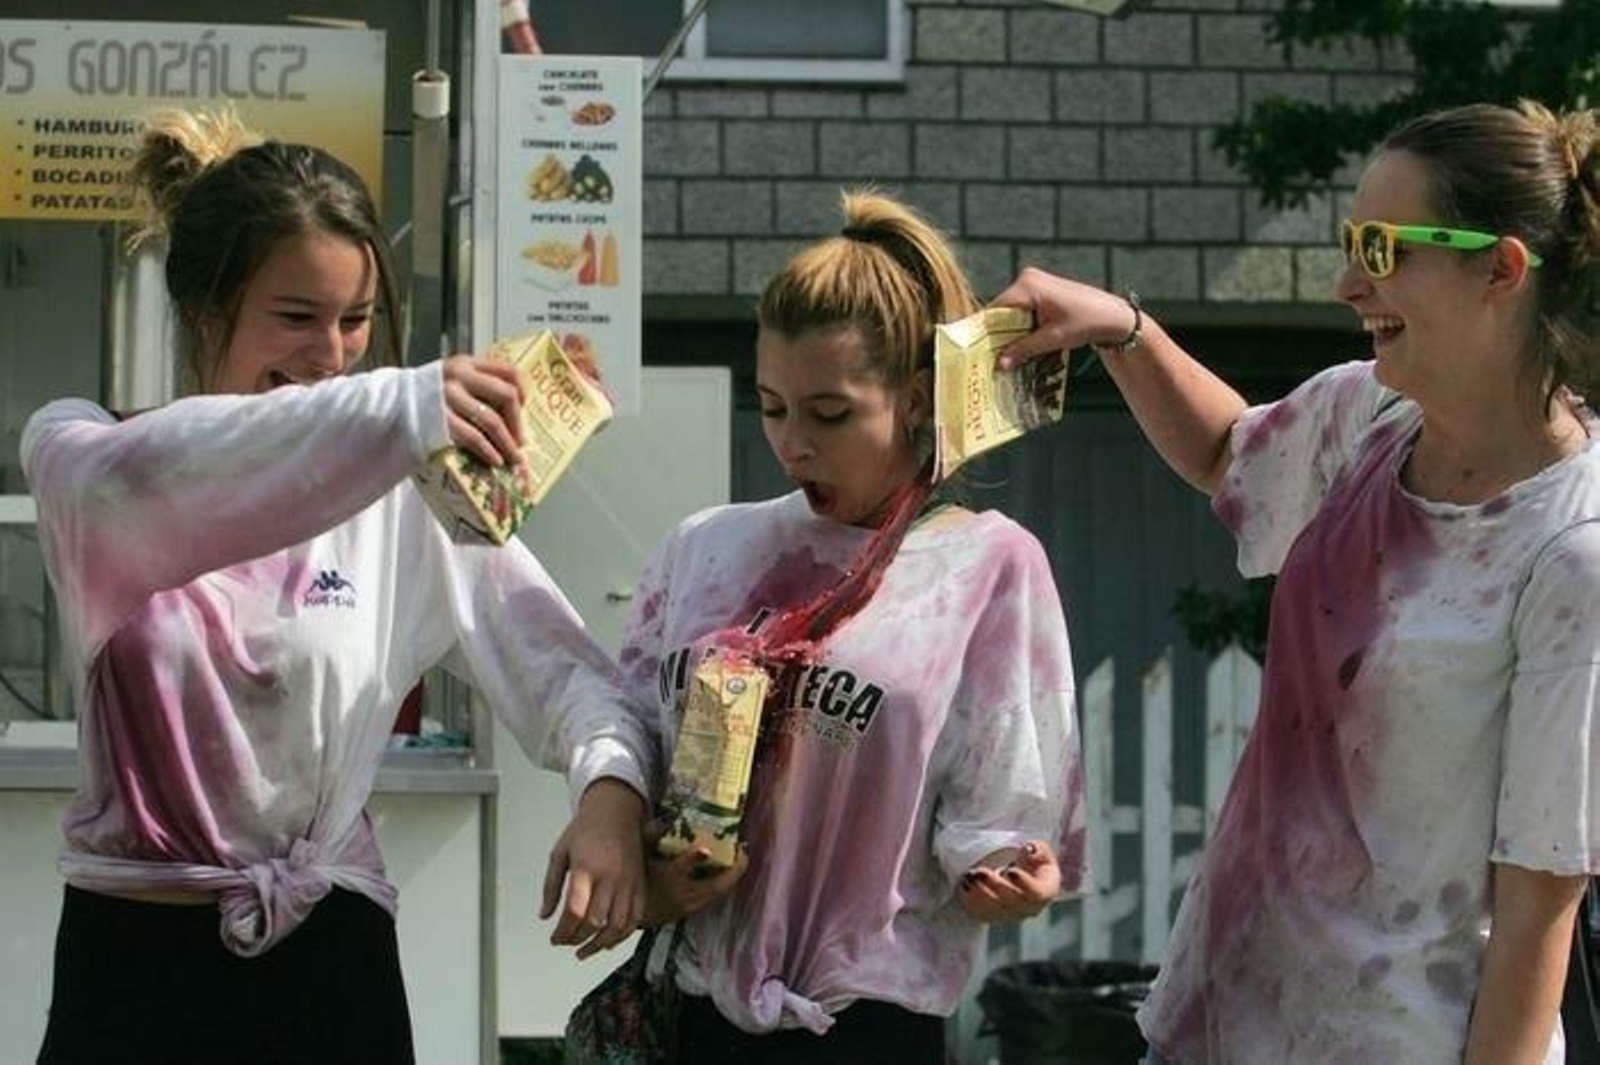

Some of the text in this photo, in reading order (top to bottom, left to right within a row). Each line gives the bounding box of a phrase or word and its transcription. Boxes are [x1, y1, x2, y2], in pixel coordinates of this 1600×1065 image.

[33, 144, 135, 160] PERRITO
[32, 168, 123, 184] BOCADI
[550, 359, 586, 409] Gran
